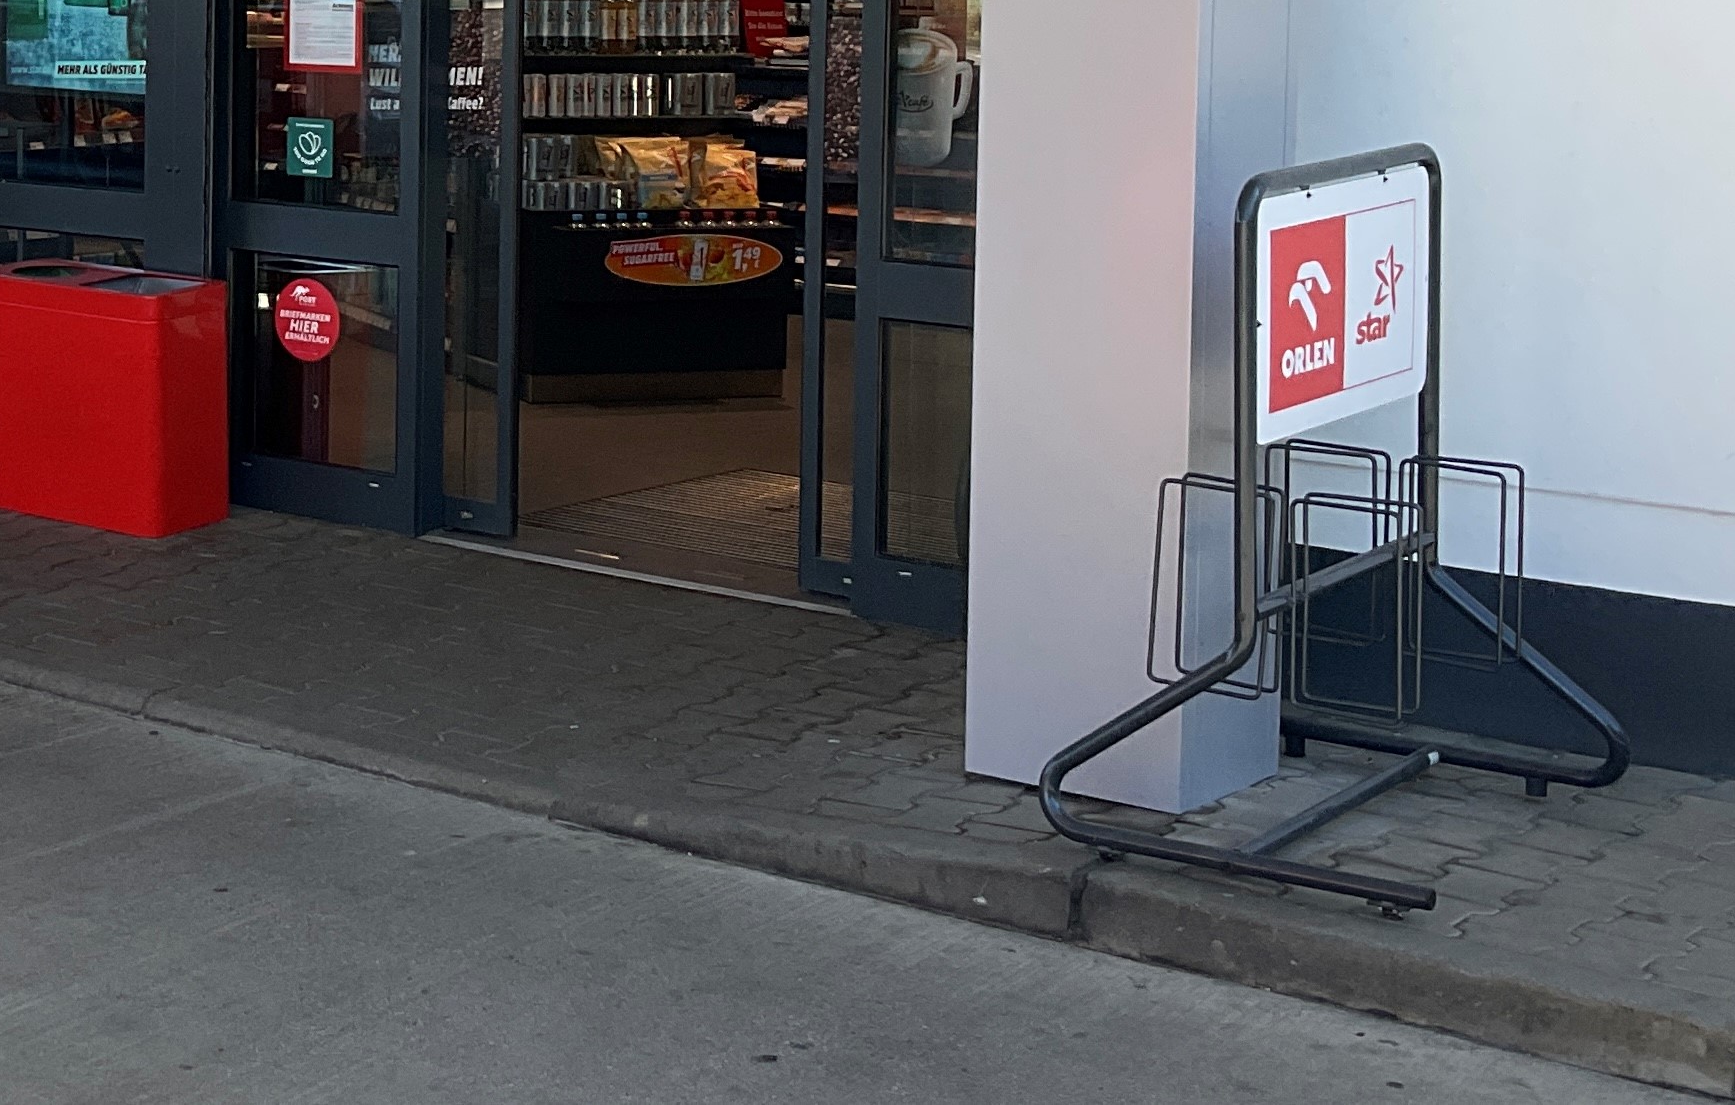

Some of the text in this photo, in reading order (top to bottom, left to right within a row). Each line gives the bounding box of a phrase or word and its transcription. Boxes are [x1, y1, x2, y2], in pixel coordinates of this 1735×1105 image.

[57, 64, 81, 75] MEHR
[83, 64, 98, 75] ALS
[100, 62, 137, 75] GÜNSTIG
[370, 97, 392, 110] Lust
[611, 241, 664, 255] POWERFUL,
[623, 251, 676, 266] SUGARFREE
[279, 309, 331, 323] BRIEFMARKEN
[289, 318, 319, 334] HIER
[1355, 311, 1391, 345] star
[284, 331, 330, 345] ERHÄLTLICH
[1281, 337, 1336, 379] ORLEN
